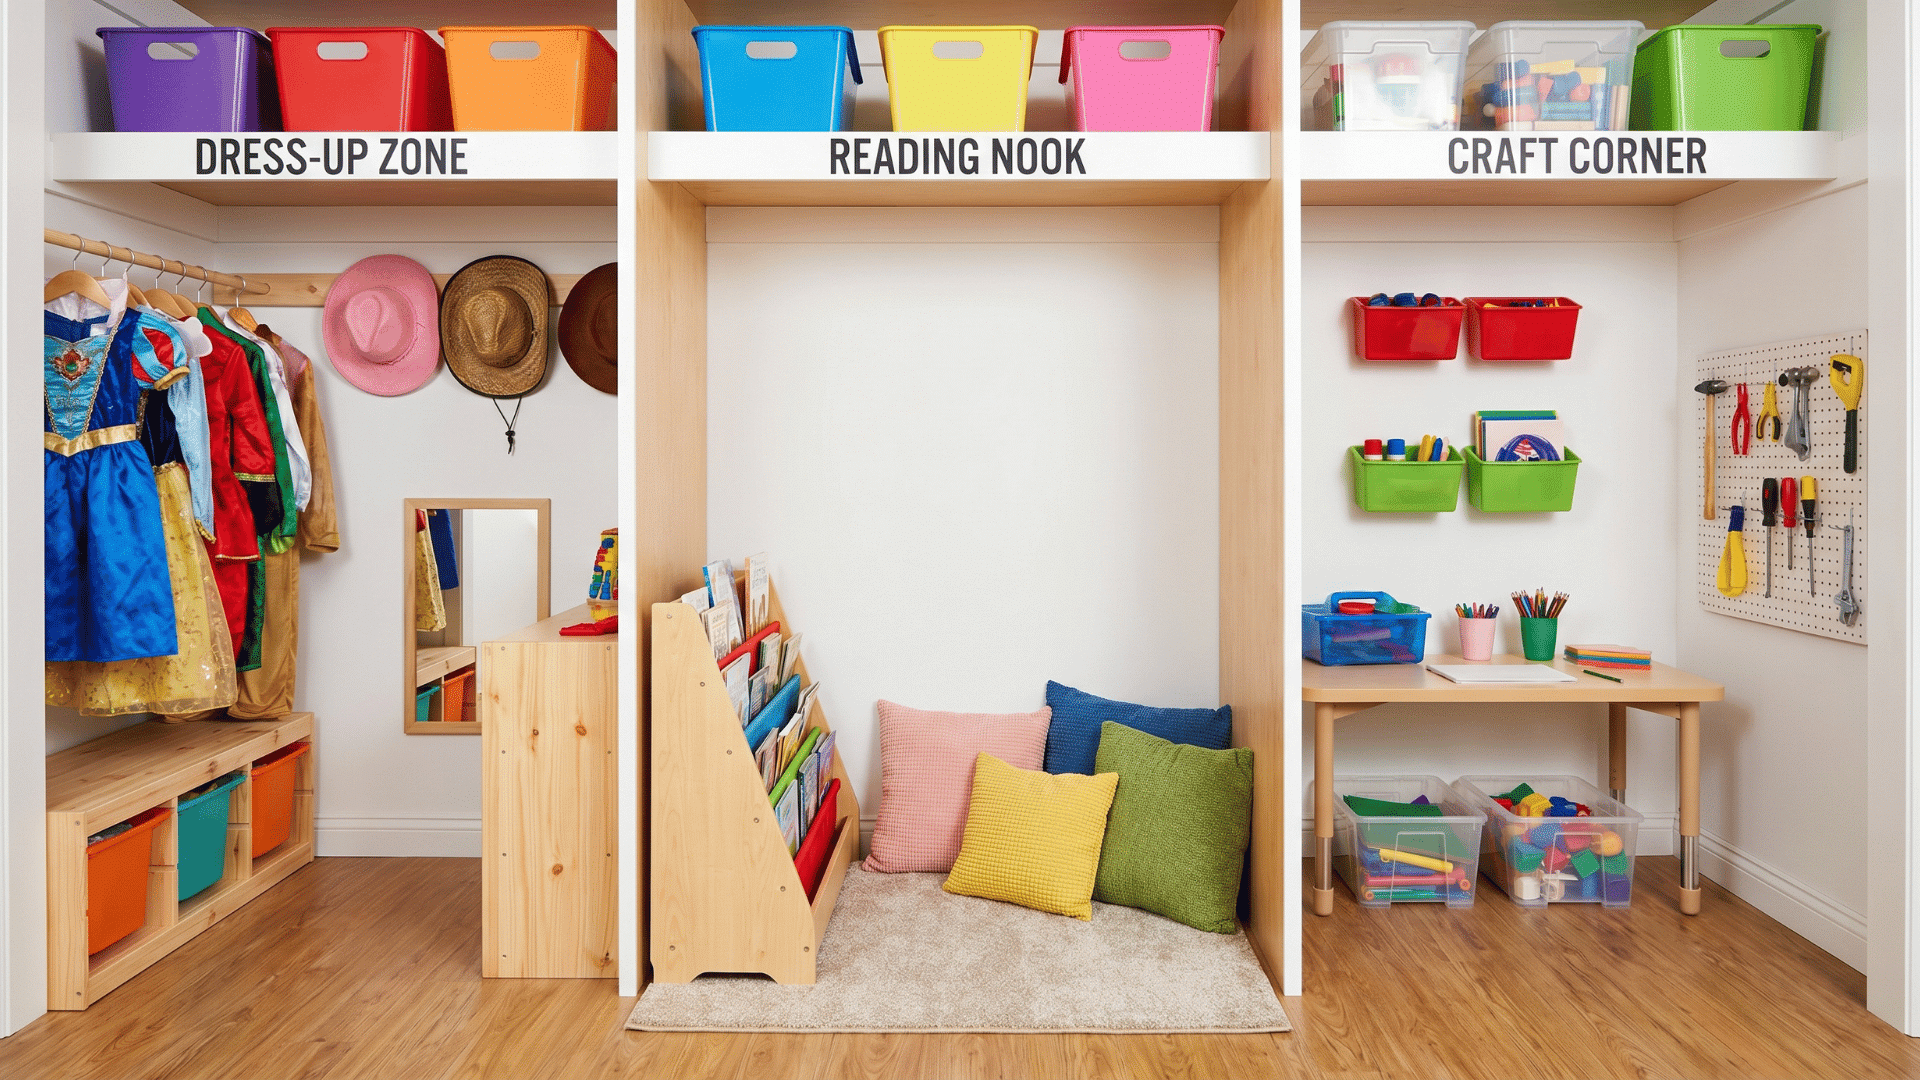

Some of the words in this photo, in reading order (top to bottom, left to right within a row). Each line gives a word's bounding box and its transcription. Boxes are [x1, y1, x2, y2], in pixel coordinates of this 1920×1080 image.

[196, 138, 367, 175] DRESS-UP
[378, 138, 468, 175] ZONE
[830, 138, 979, 175] READING
[992, 138, 1087, 175] NOOK
[1448, 137, 1559, 174] CRAFT
[1569, 137, 1707, 174] CORNER
